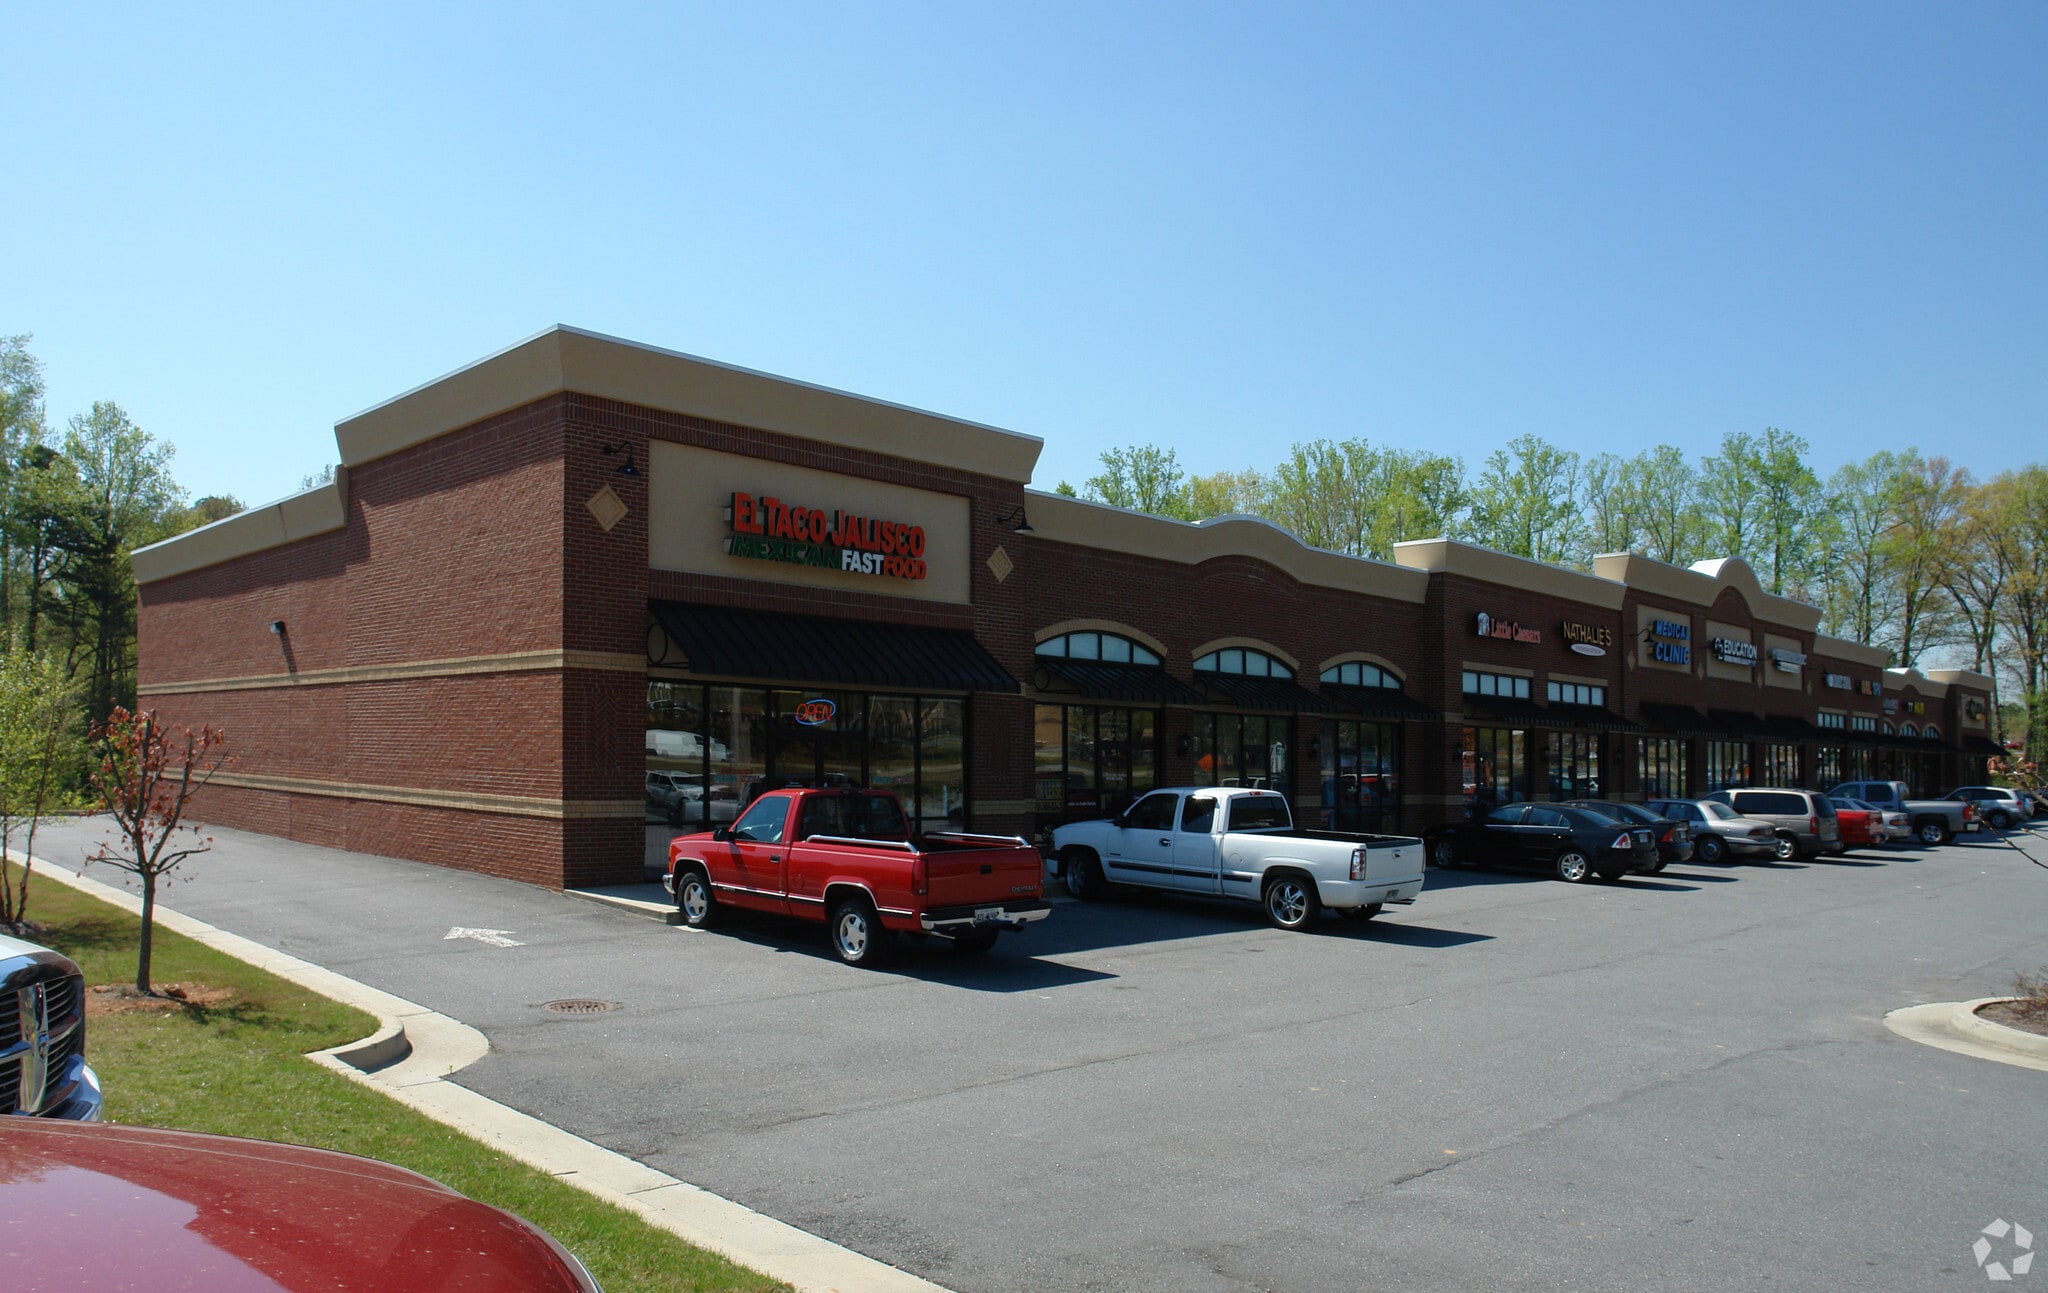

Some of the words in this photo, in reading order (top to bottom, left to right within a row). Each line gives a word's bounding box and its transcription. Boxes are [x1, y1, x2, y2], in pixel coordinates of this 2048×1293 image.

[762, 496, 827, 543] TACO
[832, 509, 925, 557] JALISCO
[732, 534, 841, 569] MEXICAN
[841, 549, 884, 575] FAST
[884, 556, 927, 580] FOOD
[1563, 621, 1612, 647] NATHALIE'S
[1656, 620, 1690, 641] MEDICAL
[1655, 641, 1690, 665] CLINIC
[1723, 639, 1758, 660] EDUCATION
[796, 703, 833, 721] OPEN
